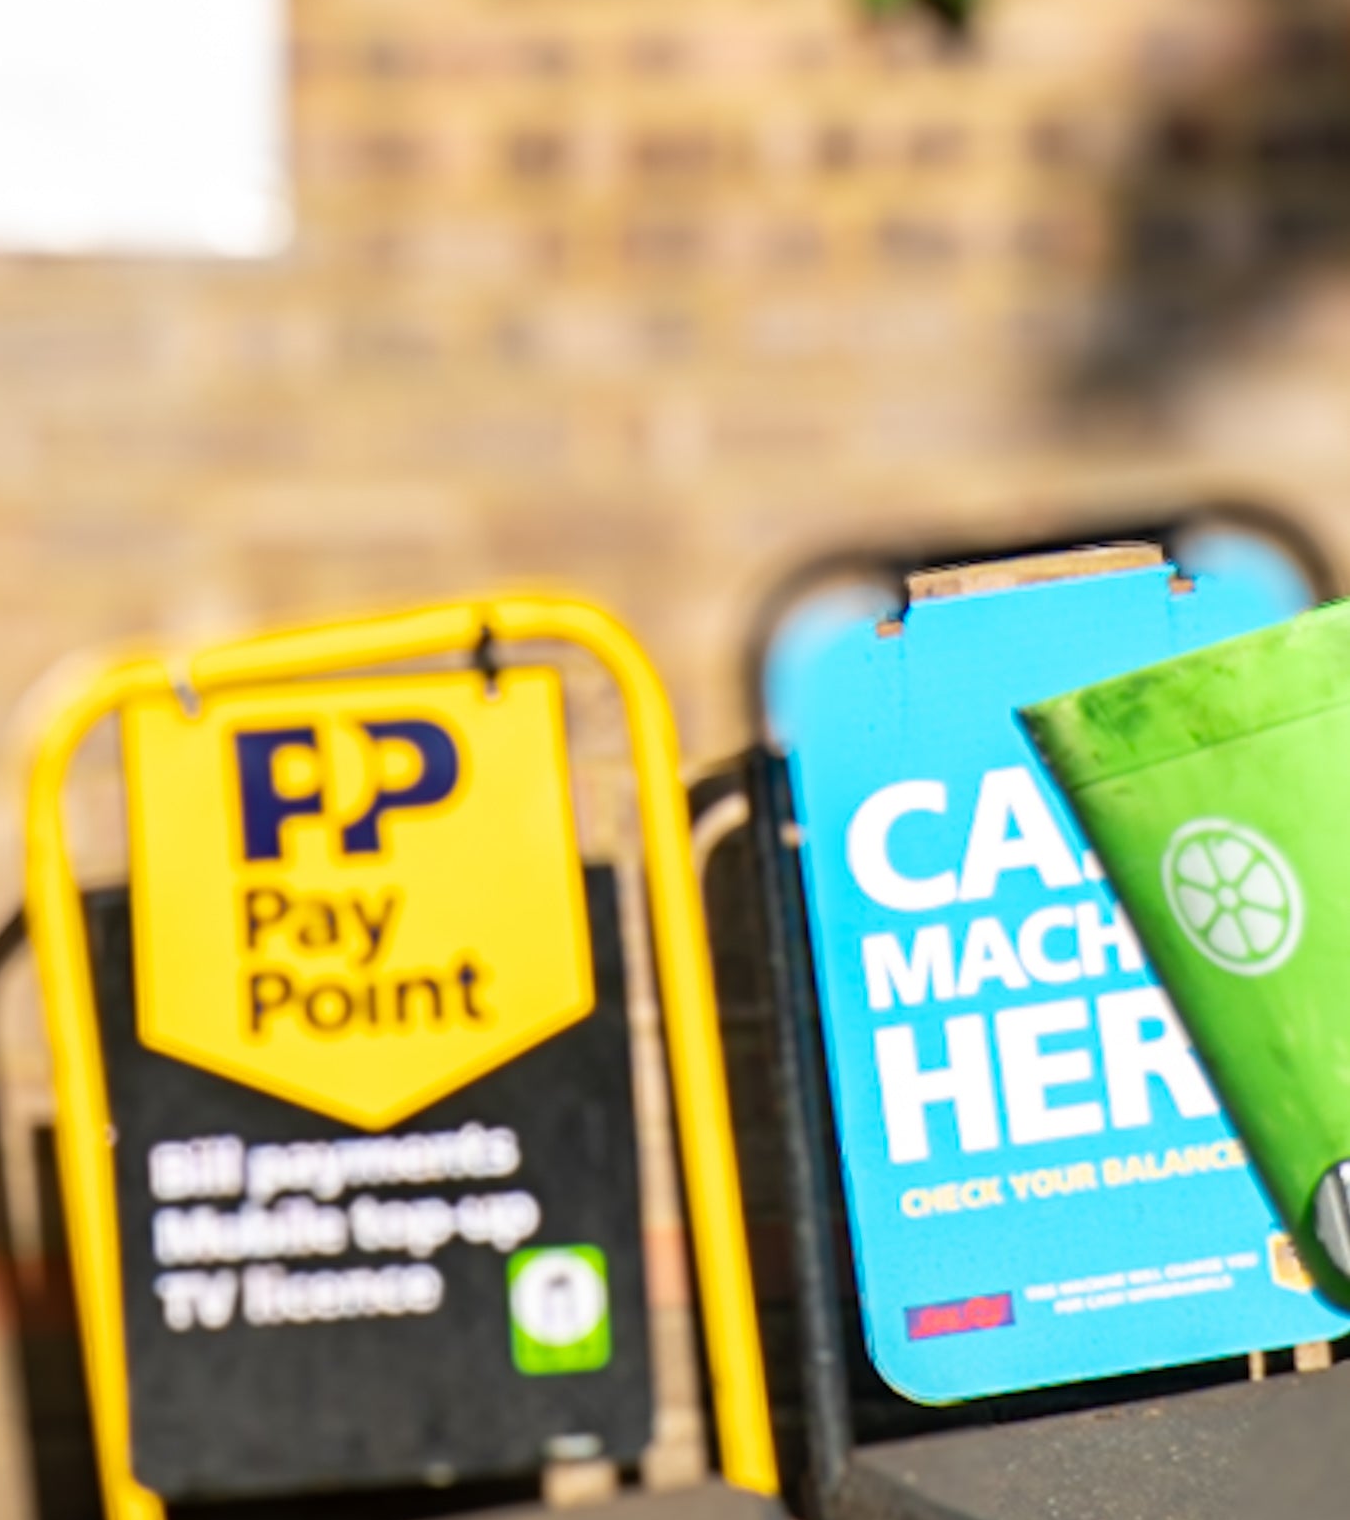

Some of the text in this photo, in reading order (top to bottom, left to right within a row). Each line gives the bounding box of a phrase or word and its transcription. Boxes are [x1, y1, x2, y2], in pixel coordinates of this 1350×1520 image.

[846, 765, 1105, 912] CA
[245, 888, 395, 965] Pay
[250, 963, 482, 1034] Point
[151, 1122, 521, 1204] Bill payments
[901, 1177, 1002, 1218] CHECK
[1009, 1163, 1098, 1201] YOUR
[153, 1197, 348, 1265] Mobile
[154, 1263, 445, 1331] TV licence
